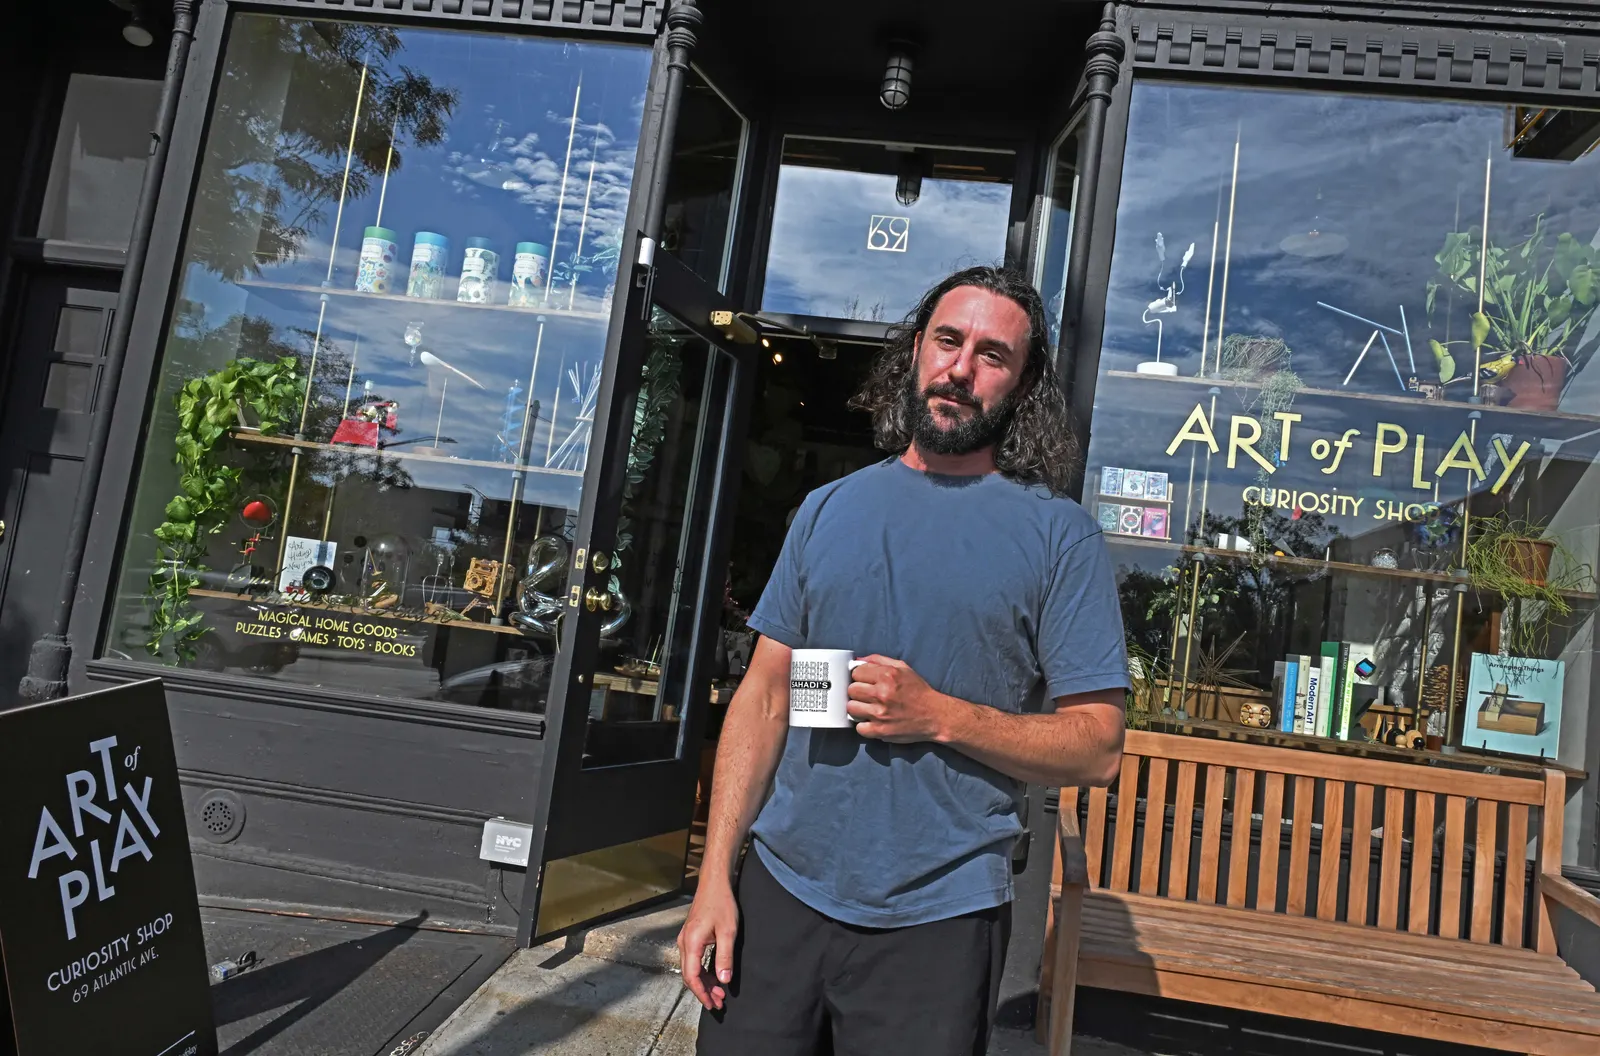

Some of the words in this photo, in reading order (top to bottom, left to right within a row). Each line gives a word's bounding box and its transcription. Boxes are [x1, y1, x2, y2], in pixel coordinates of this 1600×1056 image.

[868, 215, 909, 252] 69
[1165, 402, 1302, 475] ART
[1310, 428, 1361, 475] of
[1372, 422, 1531, 496] PLAY
[1242, 486, 1365, 517] CURIOSITY
[1373, 500, 1440, 523] SHOP
[235, 622, 281, 638] PUZZLES
[289, 629, 329, 645] GAMES
[337, 635, 365, 650] TOYS
[375, 641, 416, 657] BOOKS
[258, 610, 312, 628] MAGICAL
[315, 617, 349, 633] HOME
[353, 622, 398, 639] GOODS
[791, 681, 828, 689] SAHADI'S
[1307, 677, 1318, 712] Modern
[1306, 712, 1314, 725] Art
[28, 735, 118, 879] ART
[124, 746, 141, 770] of
[58, 776, 161, 941] PLAY
[495, 834, 522, 848] NYC
[47, 933, 131, 992] CURIOSITY
[136, 913, 173, 947] SHOP
[72, 979, 89, 1003] 69
[93, 956, 137, 993] ATLANTIC
[140, 946, 159, 967] AVE.
